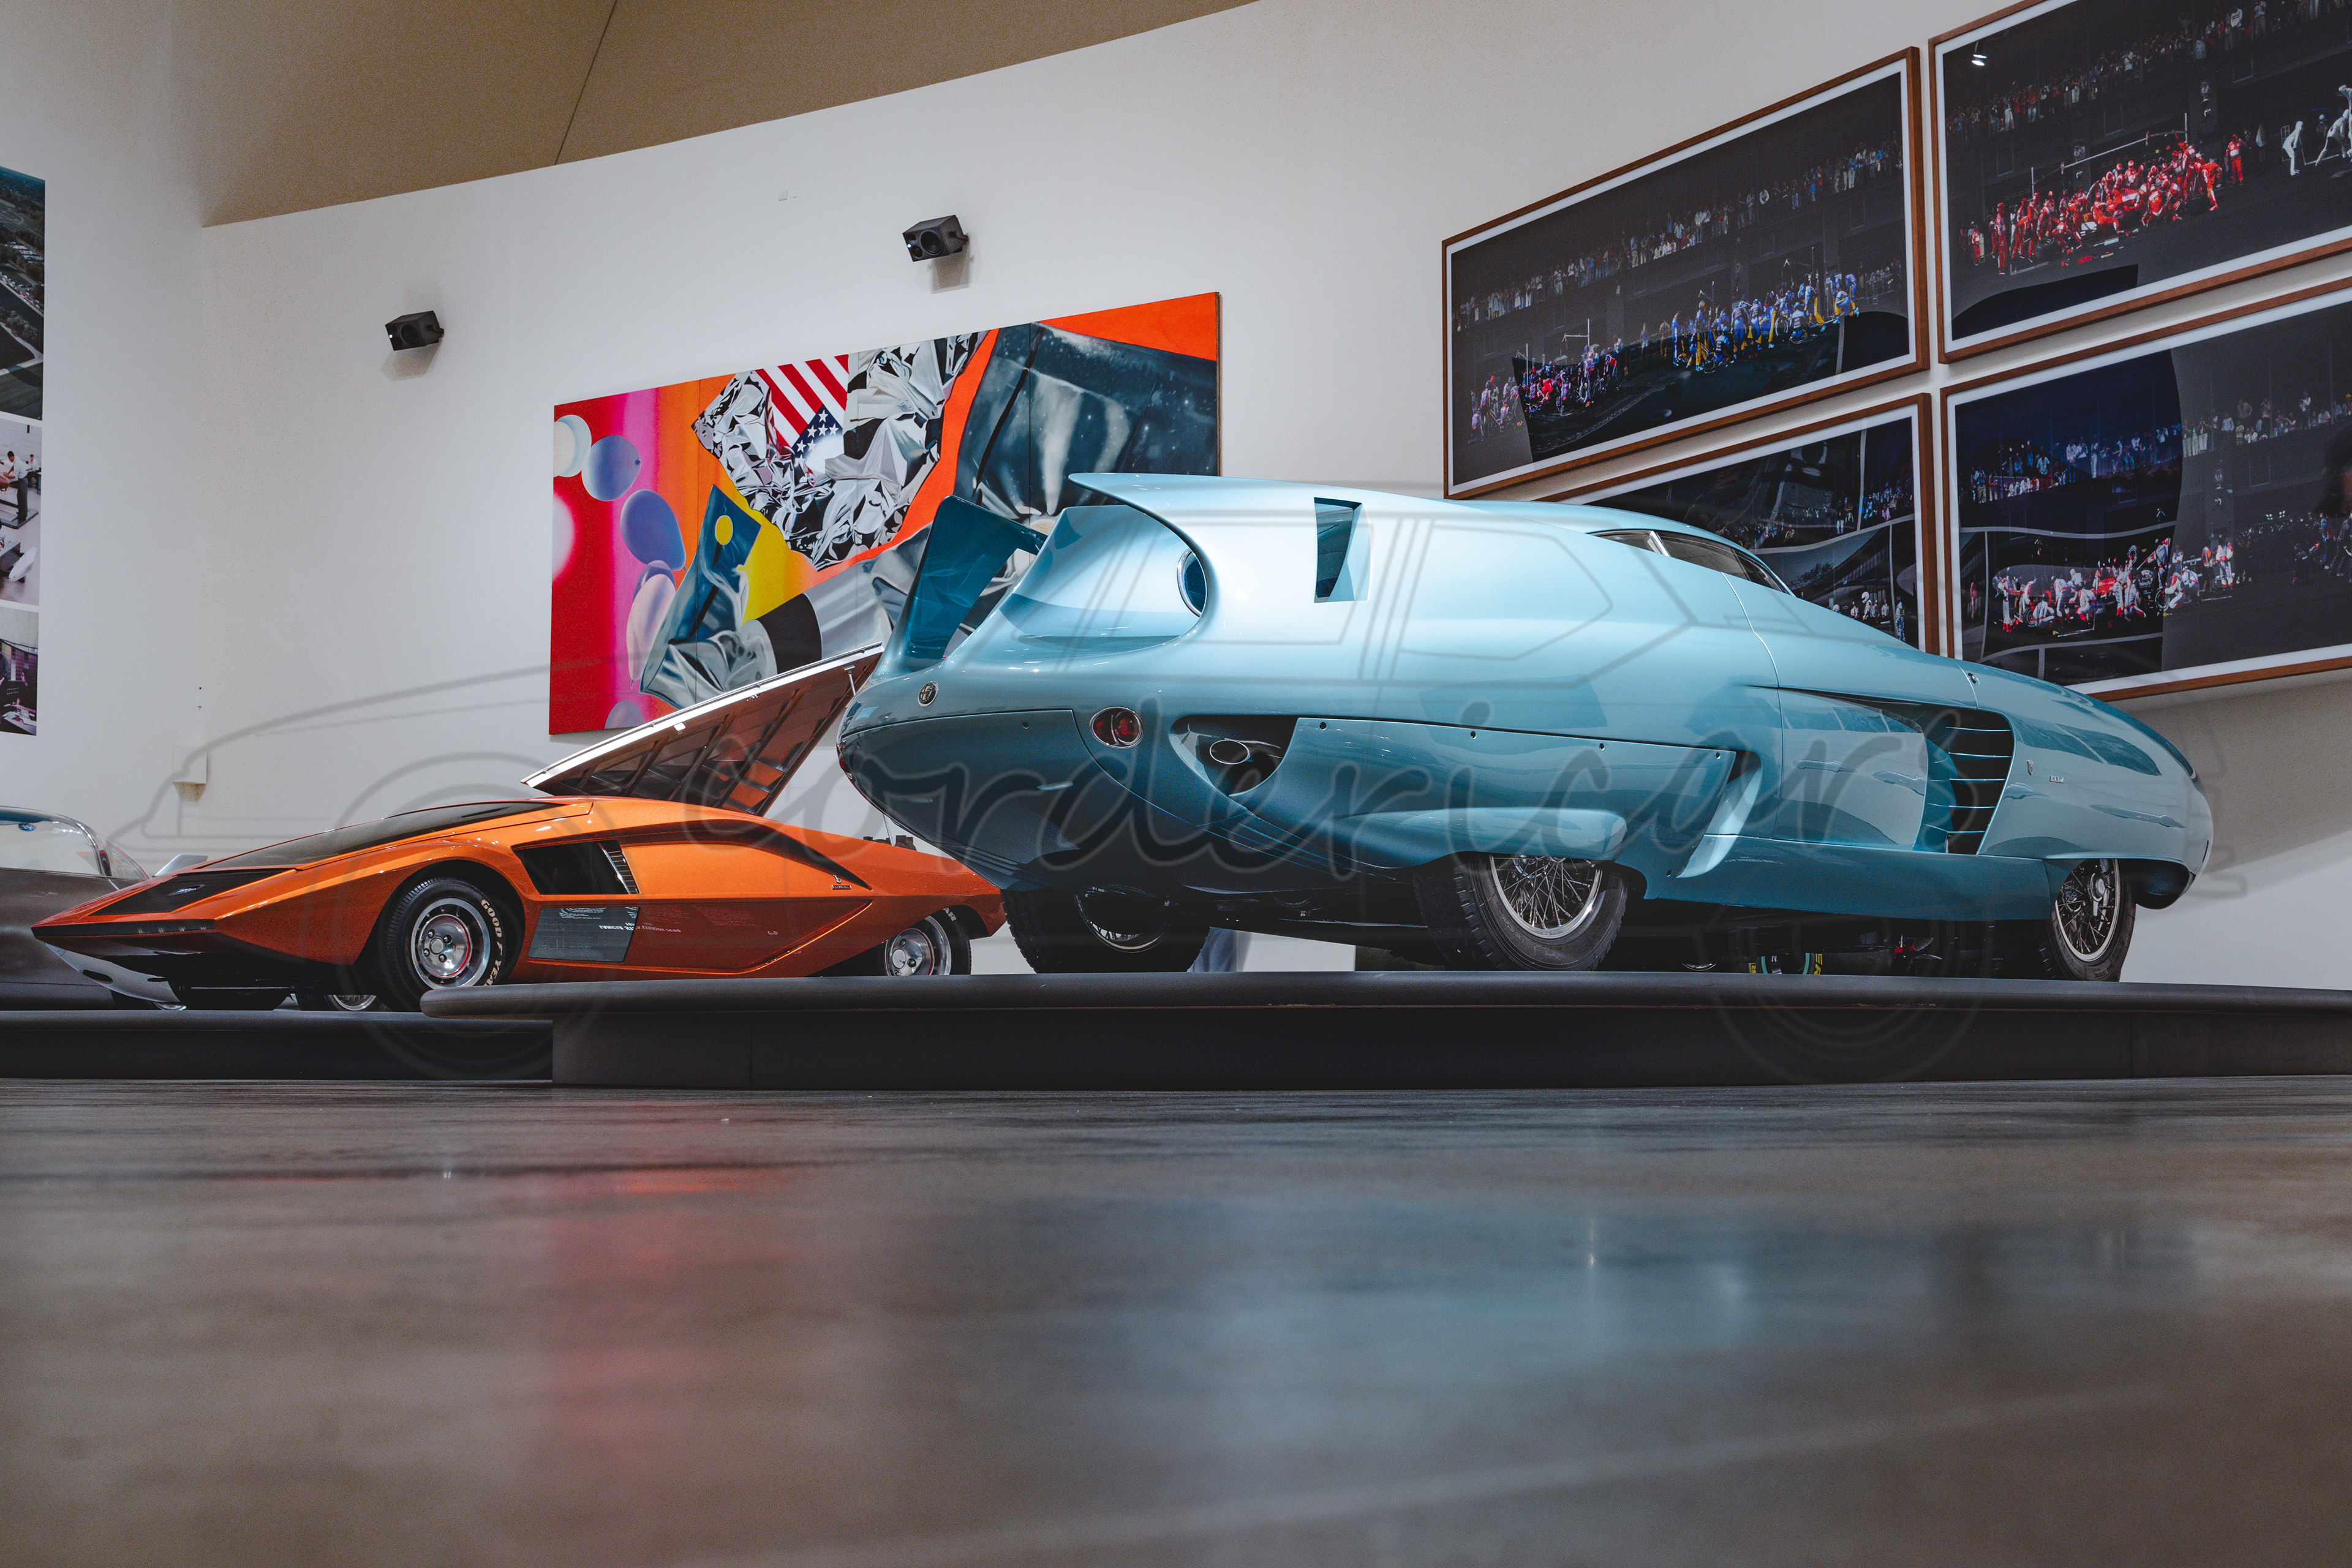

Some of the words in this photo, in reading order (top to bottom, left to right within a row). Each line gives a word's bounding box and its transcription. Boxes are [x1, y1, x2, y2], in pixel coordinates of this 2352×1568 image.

[481, 899, 502, 938] GOOD
[942, 907, 956, 921] AR
[483, 960, 502, 986] YEA
